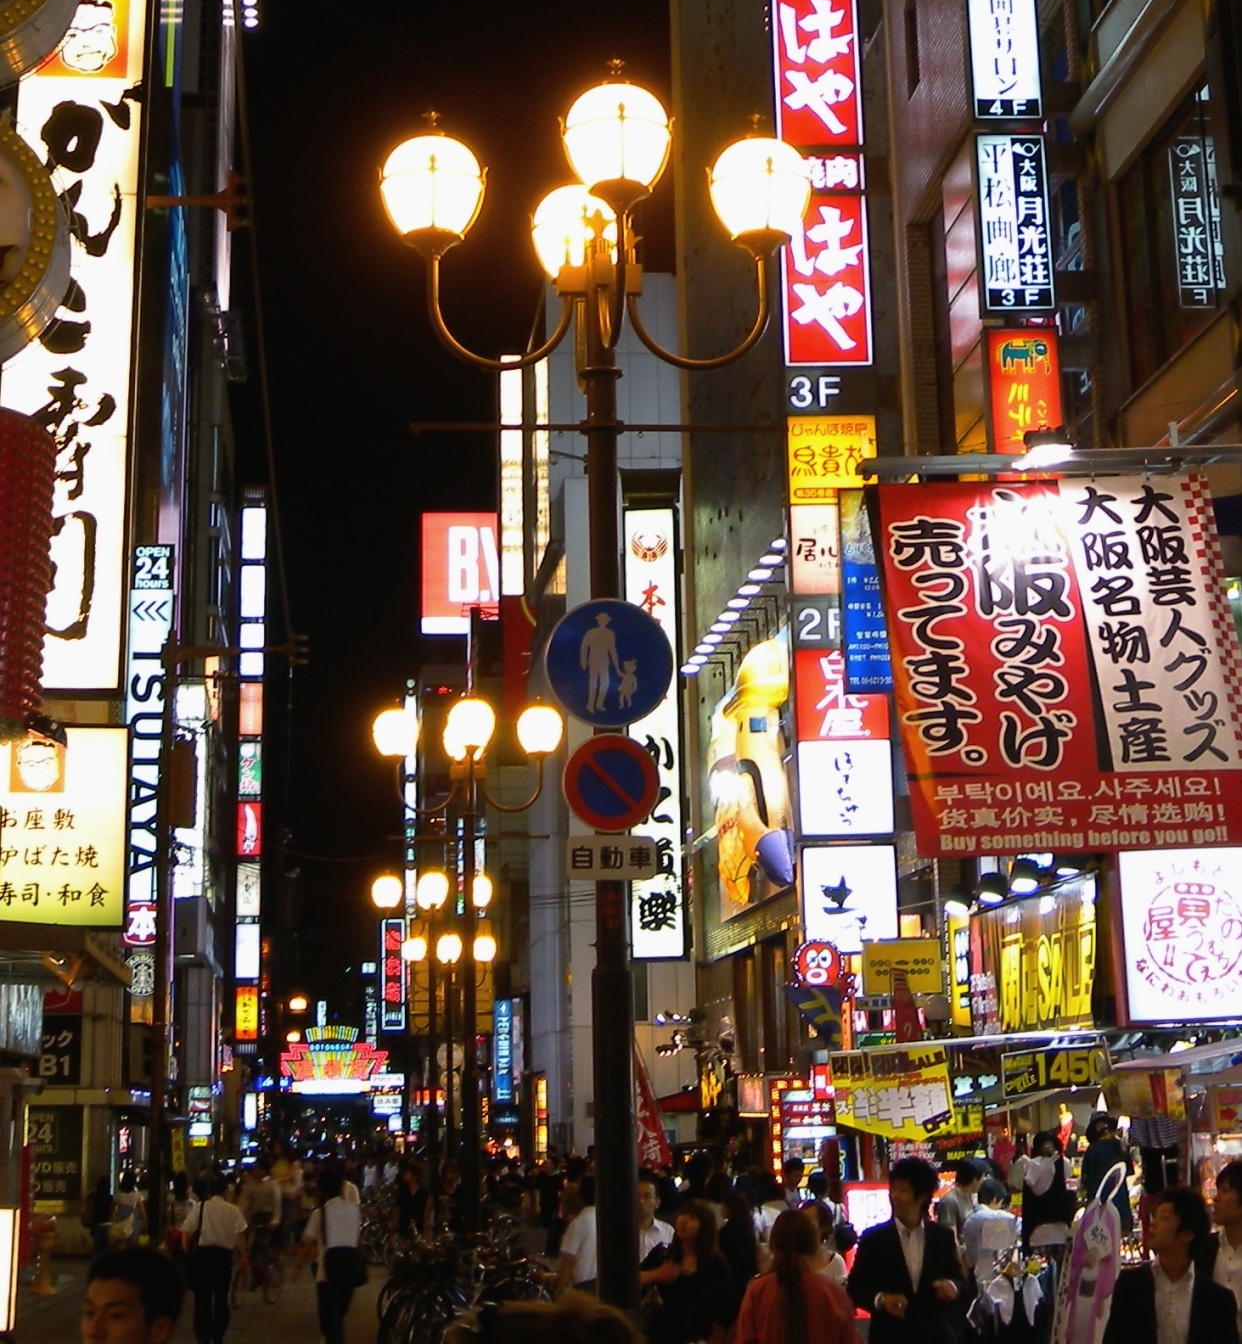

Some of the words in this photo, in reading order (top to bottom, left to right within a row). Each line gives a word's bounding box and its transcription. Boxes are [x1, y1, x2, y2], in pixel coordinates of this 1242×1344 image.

[1018, 159, 1038, 193] 大阪
[1017, 196, 1050, 285] 月光荘
[790, 206, 864, 351] はや
[1002, 289, 1040, 306] 3F
[790, 376, 841, 407] 3F
[136, 546, 170, 557] OPEN
[134, 579, 169, 588] hours
[135, 557, 170, 580] 24
[970, 490, 1075, 767] 阪みやげ
[1076, 487, 1171, 763] 大阪名物土産
[1130, 485, 1229, 762] 大阪芸人グッズ
[890, 520, 988, 765] 売ってます。
[0, 807, 75, 830] お座敷
[940, 833, 976, 852] Buy
[981, 829, 1081, 849] something
[1088, 828, 1151, 846] before
[1154, 830, 1189, 846] you
[1192, 825, 1228, 843] go!!
[571, 844, 652, 870] 自動車
[1037, 920, 1096, 1023] SALE
[39, 1054, 70, 1076] B1
